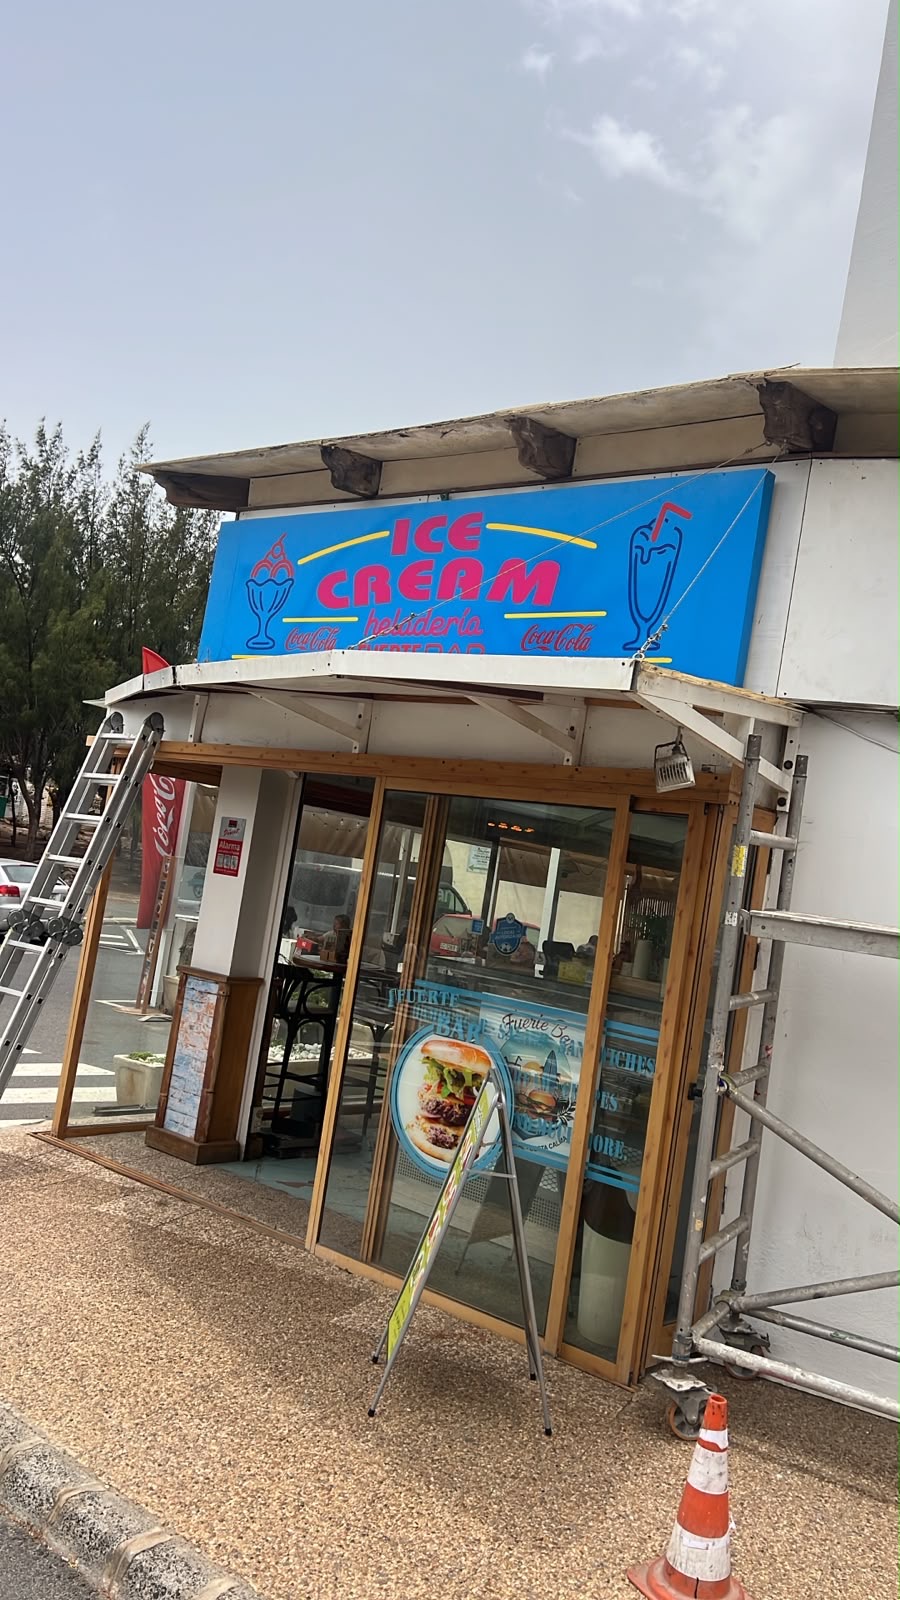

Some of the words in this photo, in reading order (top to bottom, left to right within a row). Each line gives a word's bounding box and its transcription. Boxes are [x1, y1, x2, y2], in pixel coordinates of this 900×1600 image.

[391, 511, 484, 556] ICE
[316, 557, 560, 609] CREAM
[364, 607, 484, 636] heladería
